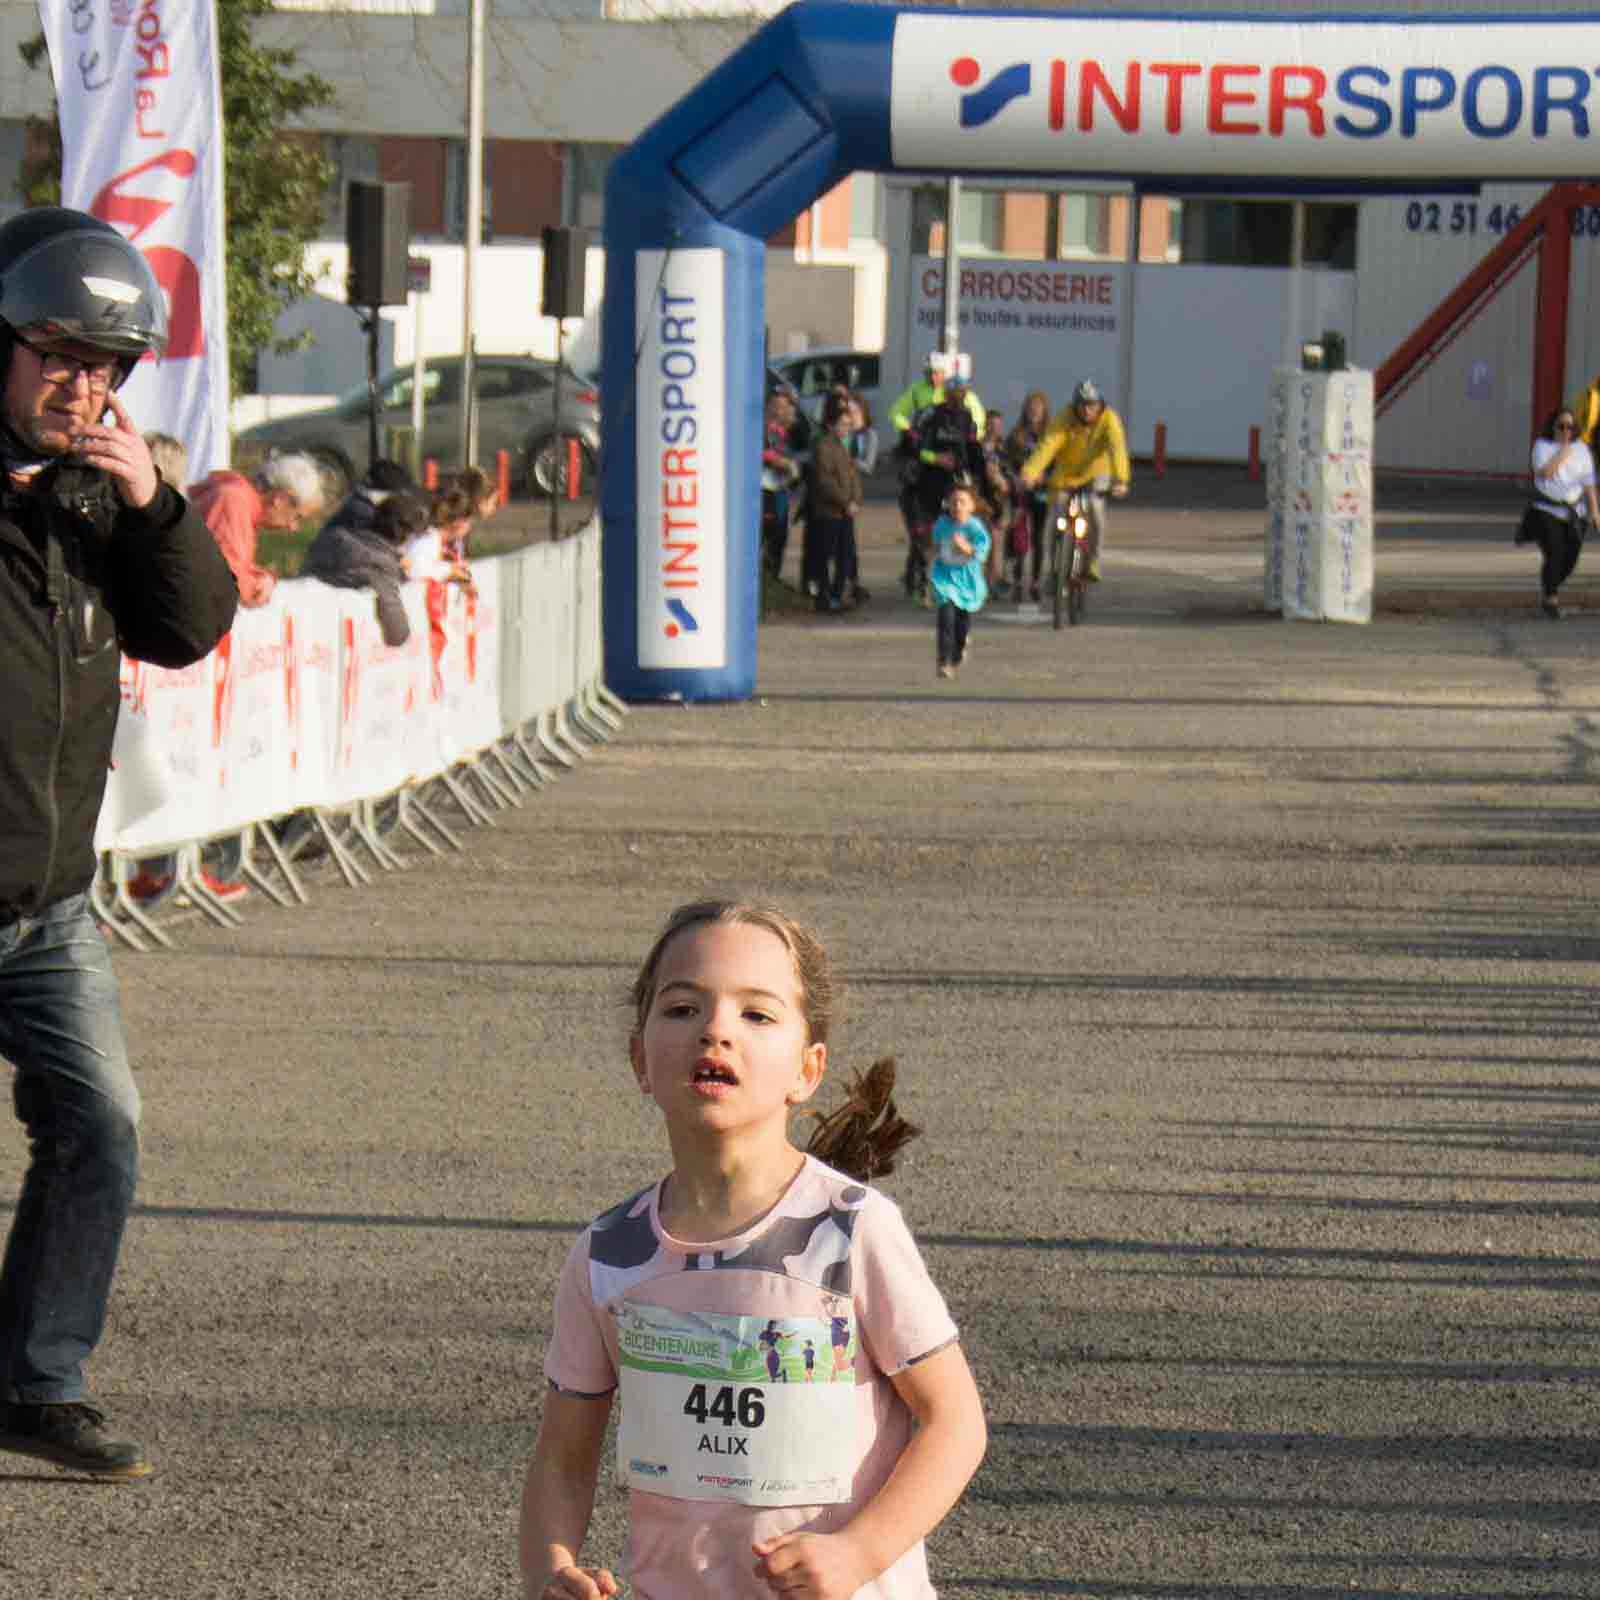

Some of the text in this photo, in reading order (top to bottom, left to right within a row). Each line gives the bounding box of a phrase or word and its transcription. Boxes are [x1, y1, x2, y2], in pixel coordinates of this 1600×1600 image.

[1407, 200, 1441, 232] 02
[1450, 200, 1479, 232] 51
[921, 267, 1114, 304] CRROSSERIE
[661, 289, 698, 589] INTERSPORT
[623, 1333, 720, 1362] BICENTENAIRE
[683, 1384, 765, 1428] 446
[698, 1434, 749, 1456] ALIX
